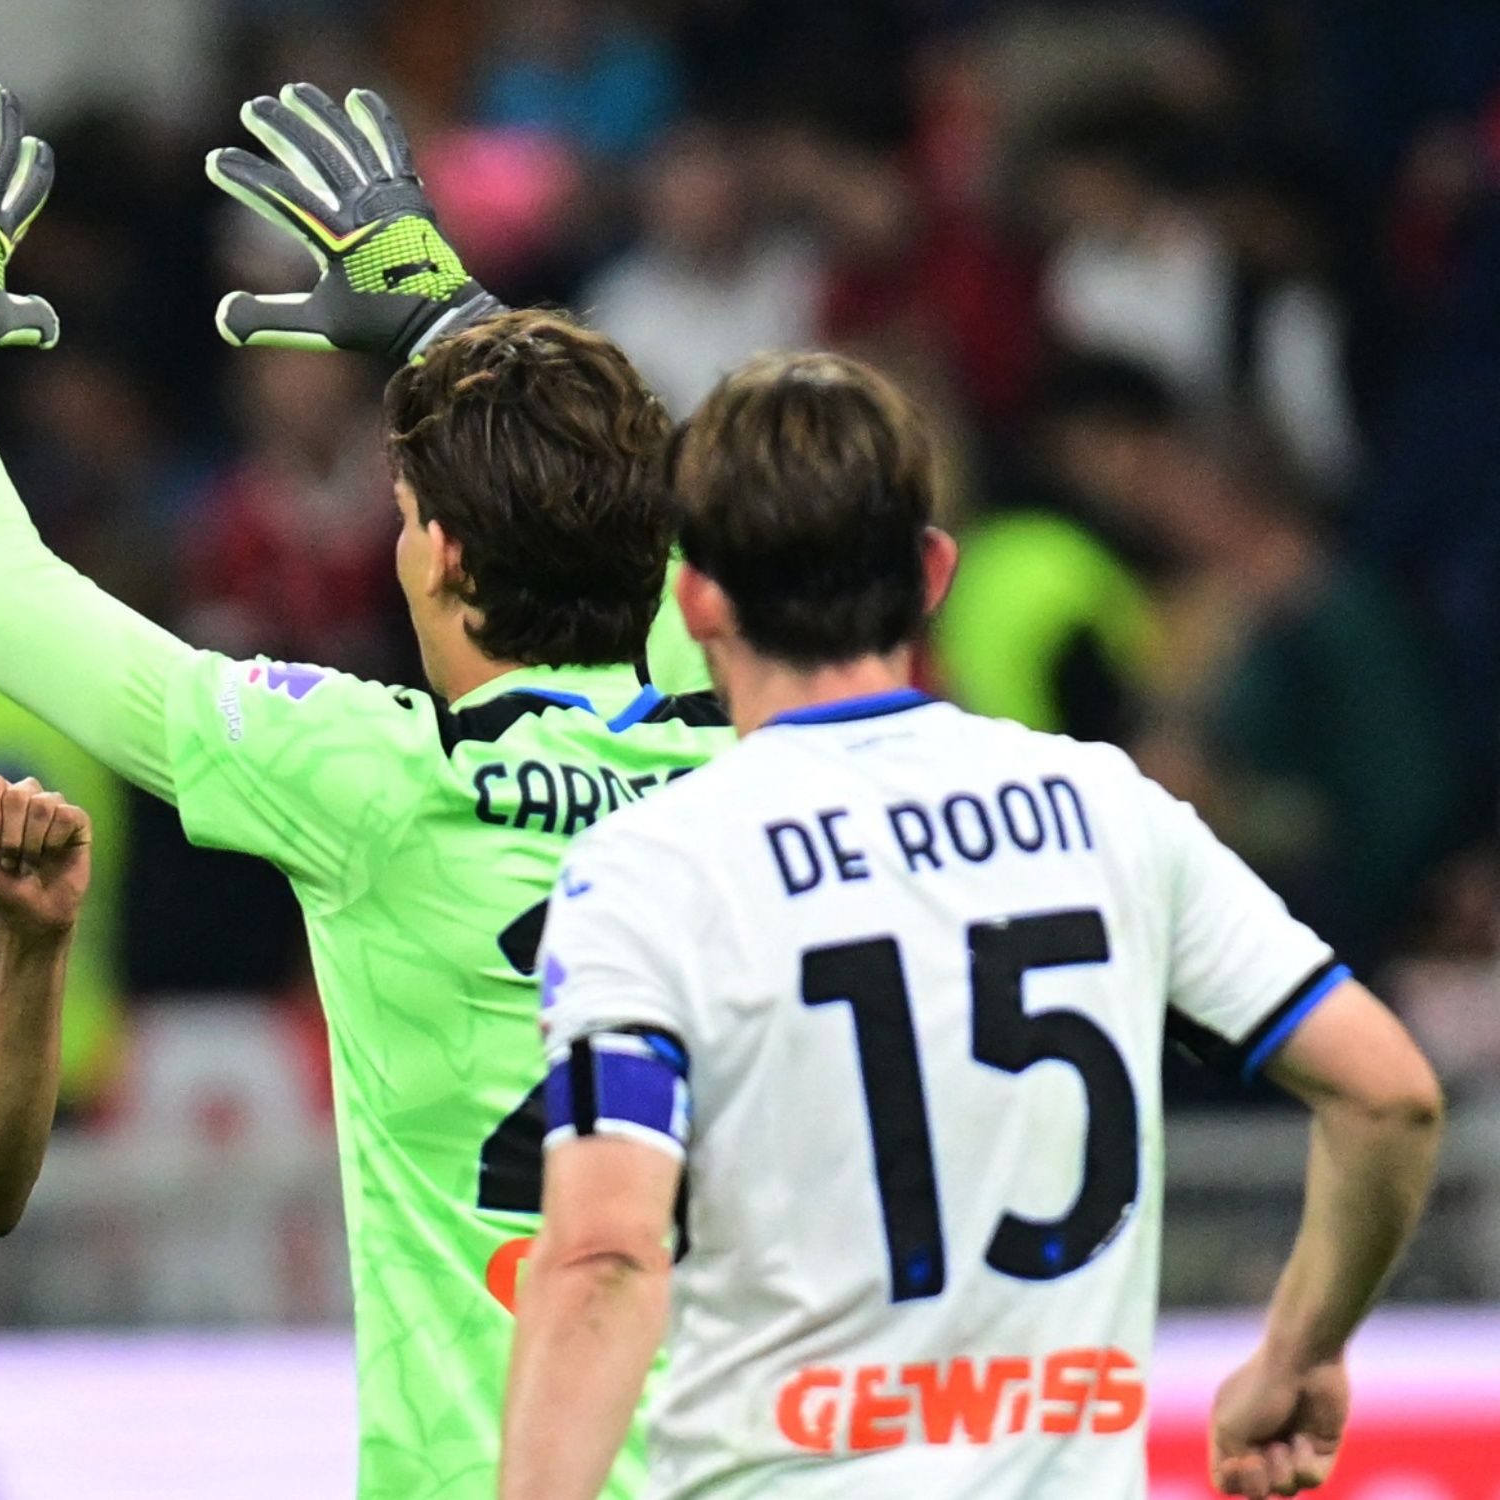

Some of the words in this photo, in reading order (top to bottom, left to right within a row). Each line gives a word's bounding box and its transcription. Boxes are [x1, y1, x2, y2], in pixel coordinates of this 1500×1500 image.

[765, 808, 870, 896] DE
[889, 775, 1094, 872] ROON
[800, 906, 1141, 1304] 15
[775, 1346, 1146, 1456] GEWISS
